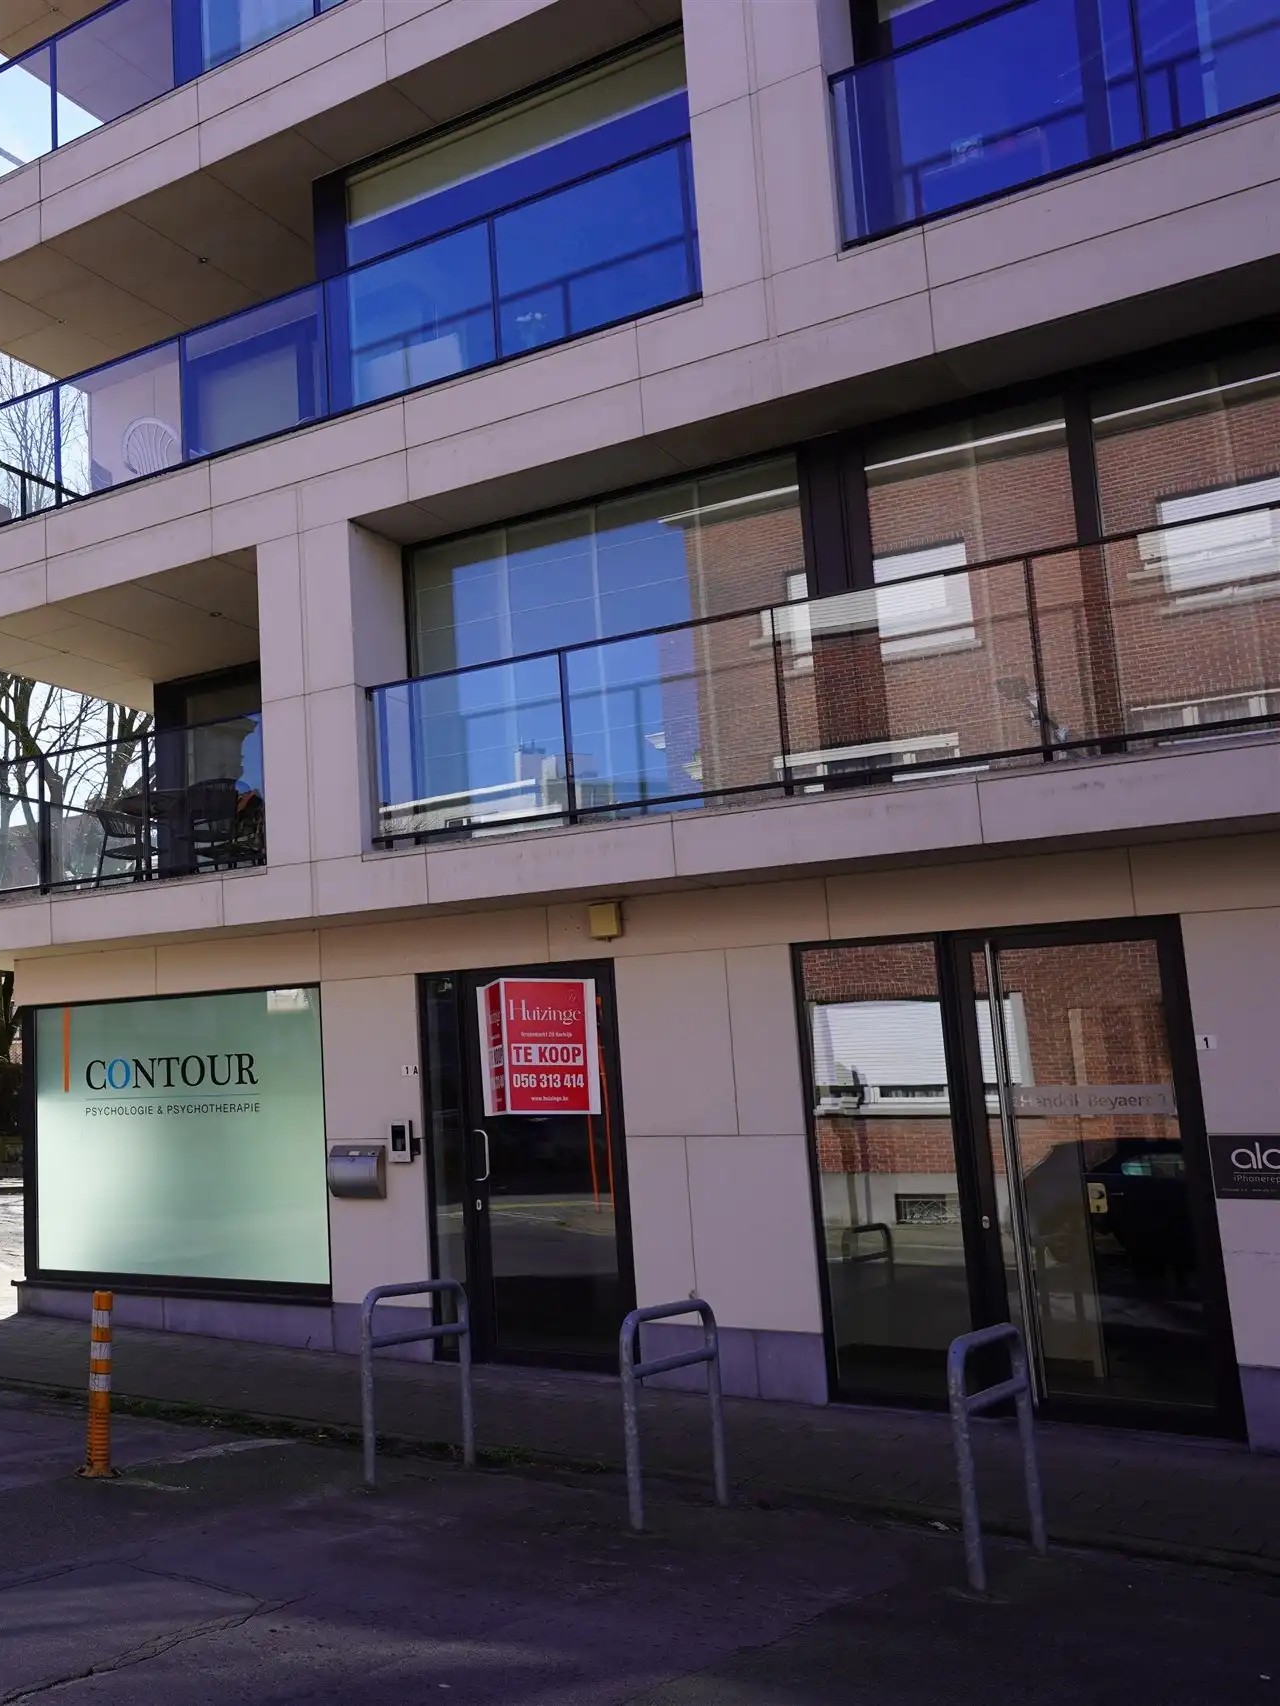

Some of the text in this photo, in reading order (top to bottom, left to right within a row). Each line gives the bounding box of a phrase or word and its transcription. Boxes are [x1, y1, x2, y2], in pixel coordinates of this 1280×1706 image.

[508, 999, 581, 1025] Huizinge
[1203, 1036, 1210, 1049] 1
[513, 1046, 533, 1063] TE
[538, 1046, 582, 1063] KOOP
[85, 1053, 259, 1090] CONTOUR
[512, 1073, 537, 1088] 056
[539, 1073, 561, 1088] 313
[563, 1073, 584, 1088] 414
[85, 1103, 261, 1117] PSYCHOLOGIE & PSYCHOTHERAPIE
